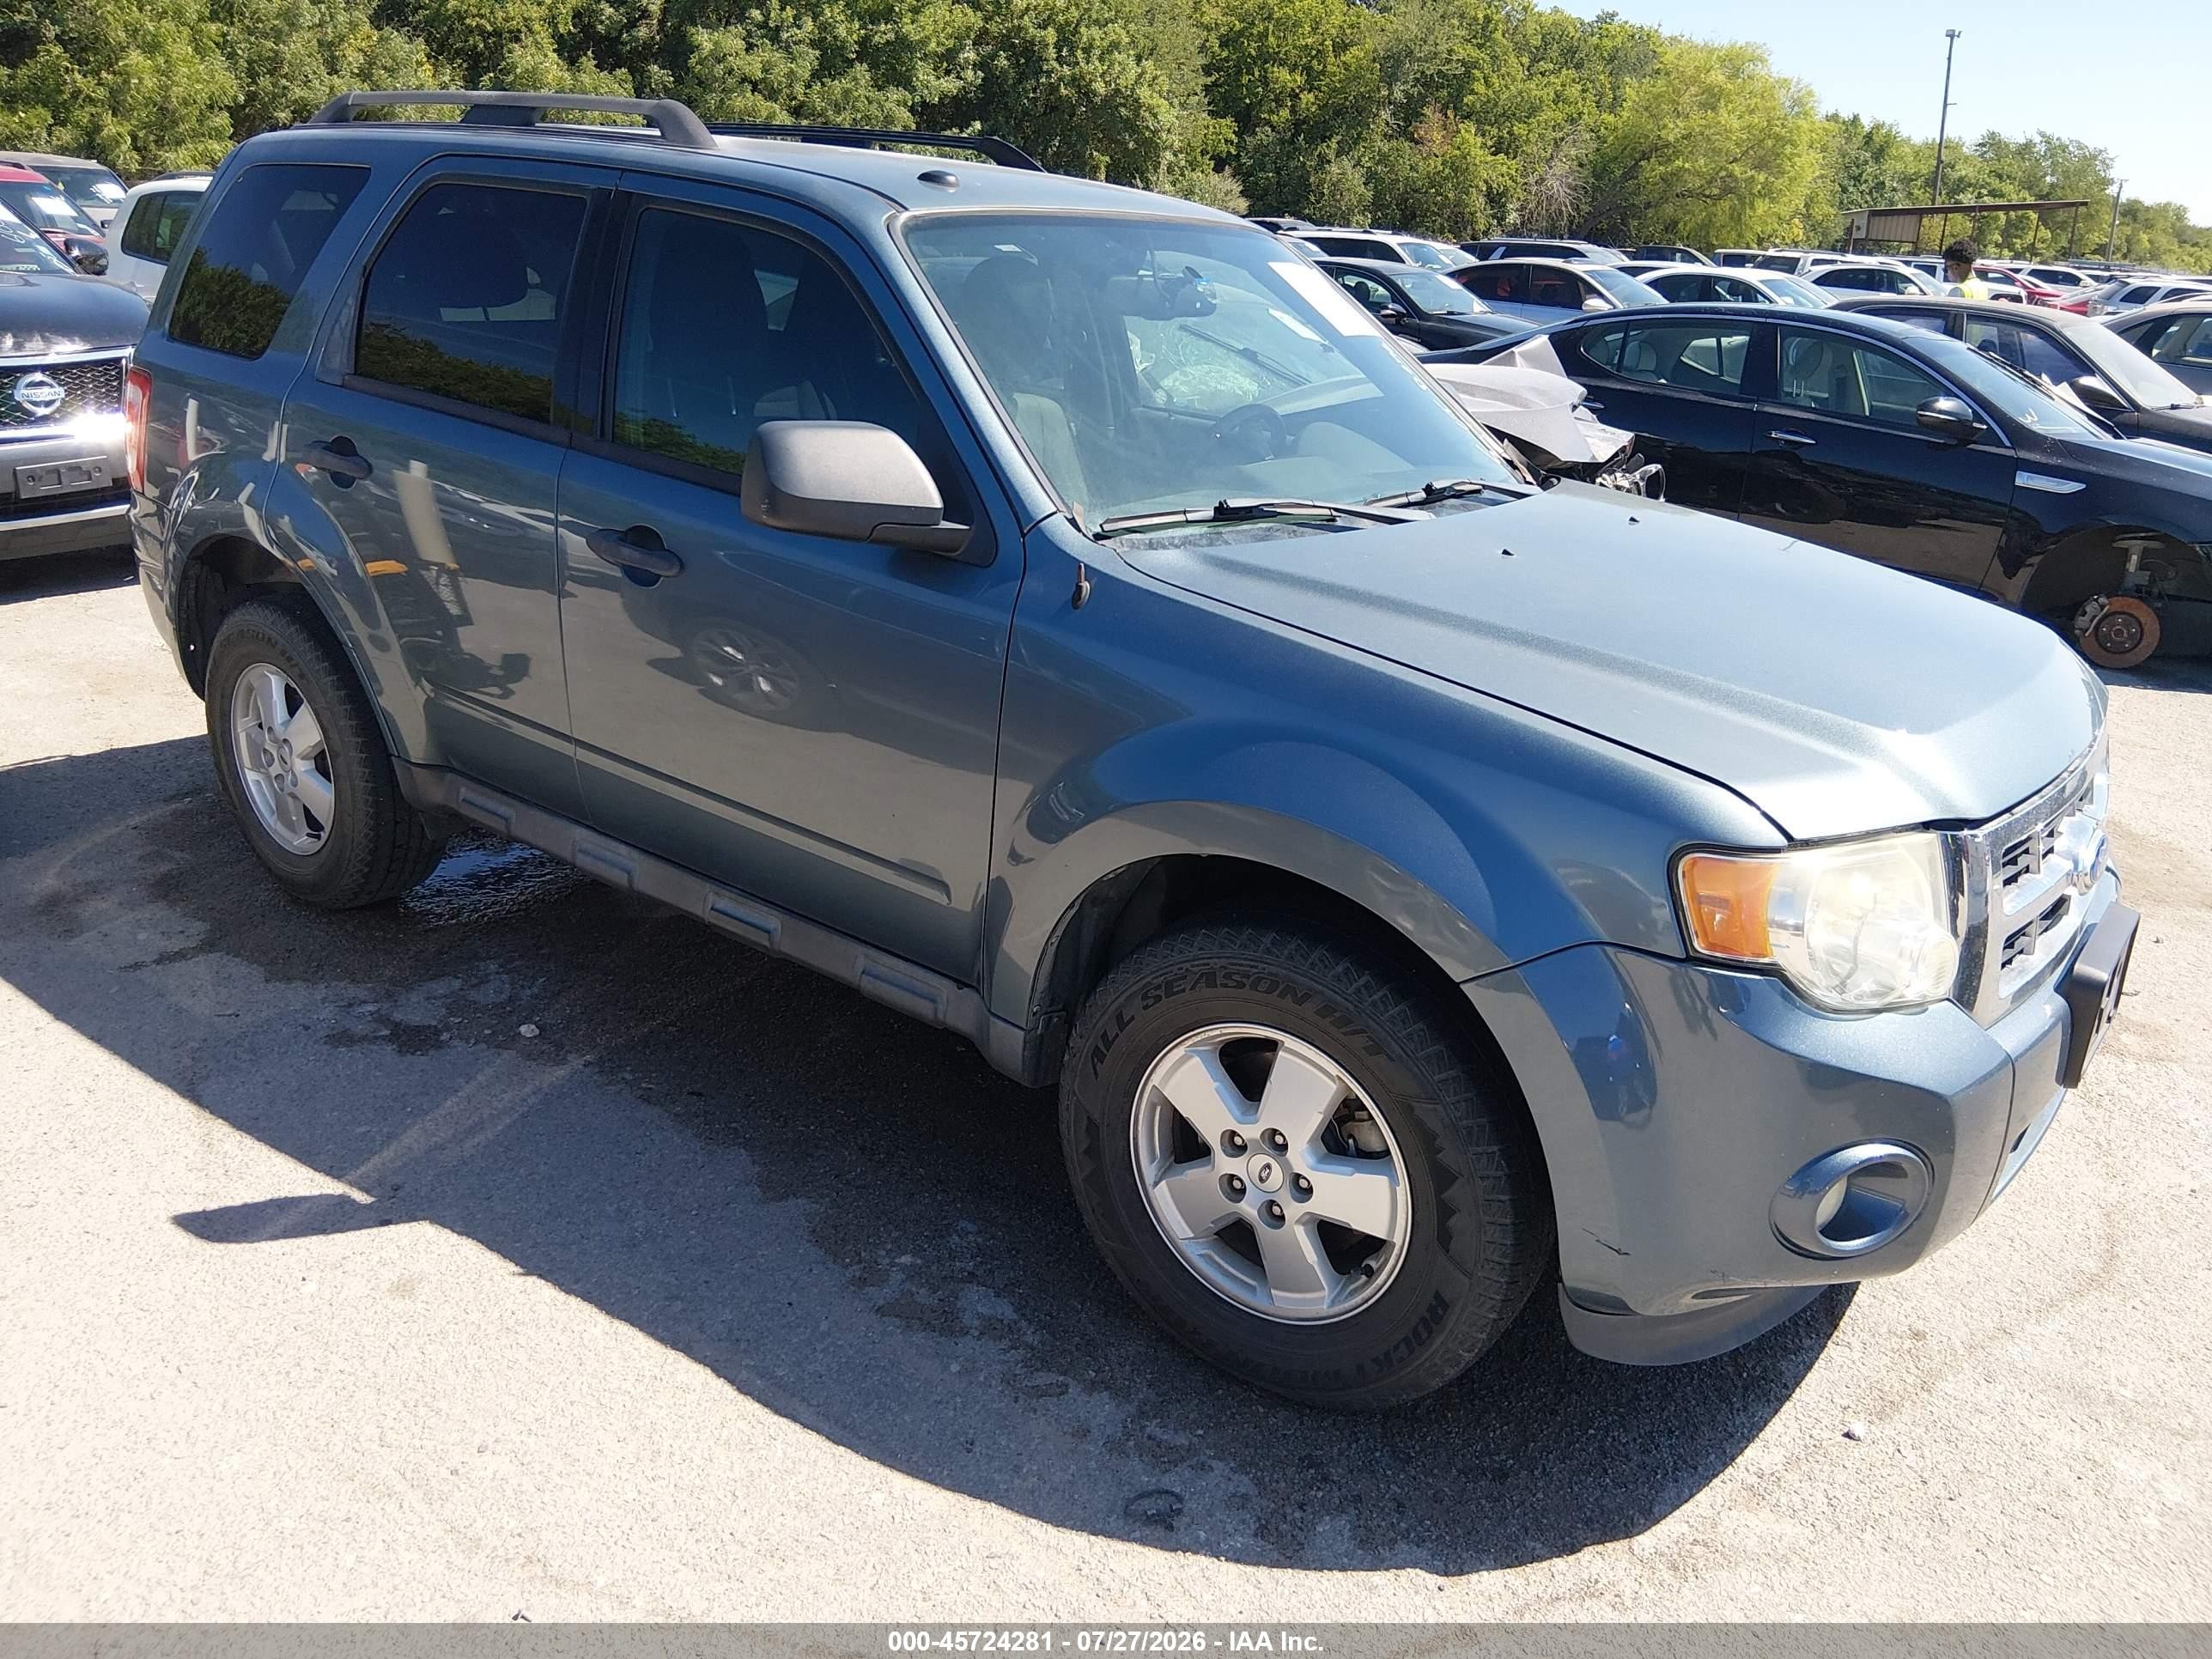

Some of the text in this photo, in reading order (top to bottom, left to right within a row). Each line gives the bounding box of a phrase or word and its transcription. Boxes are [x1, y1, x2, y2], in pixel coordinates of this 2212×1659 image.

[21, 390, 62, 399] NISSAN
[1089, 1008, 1135, 1079] ALL
[1139, 969, 1313, 1012] SEASON
